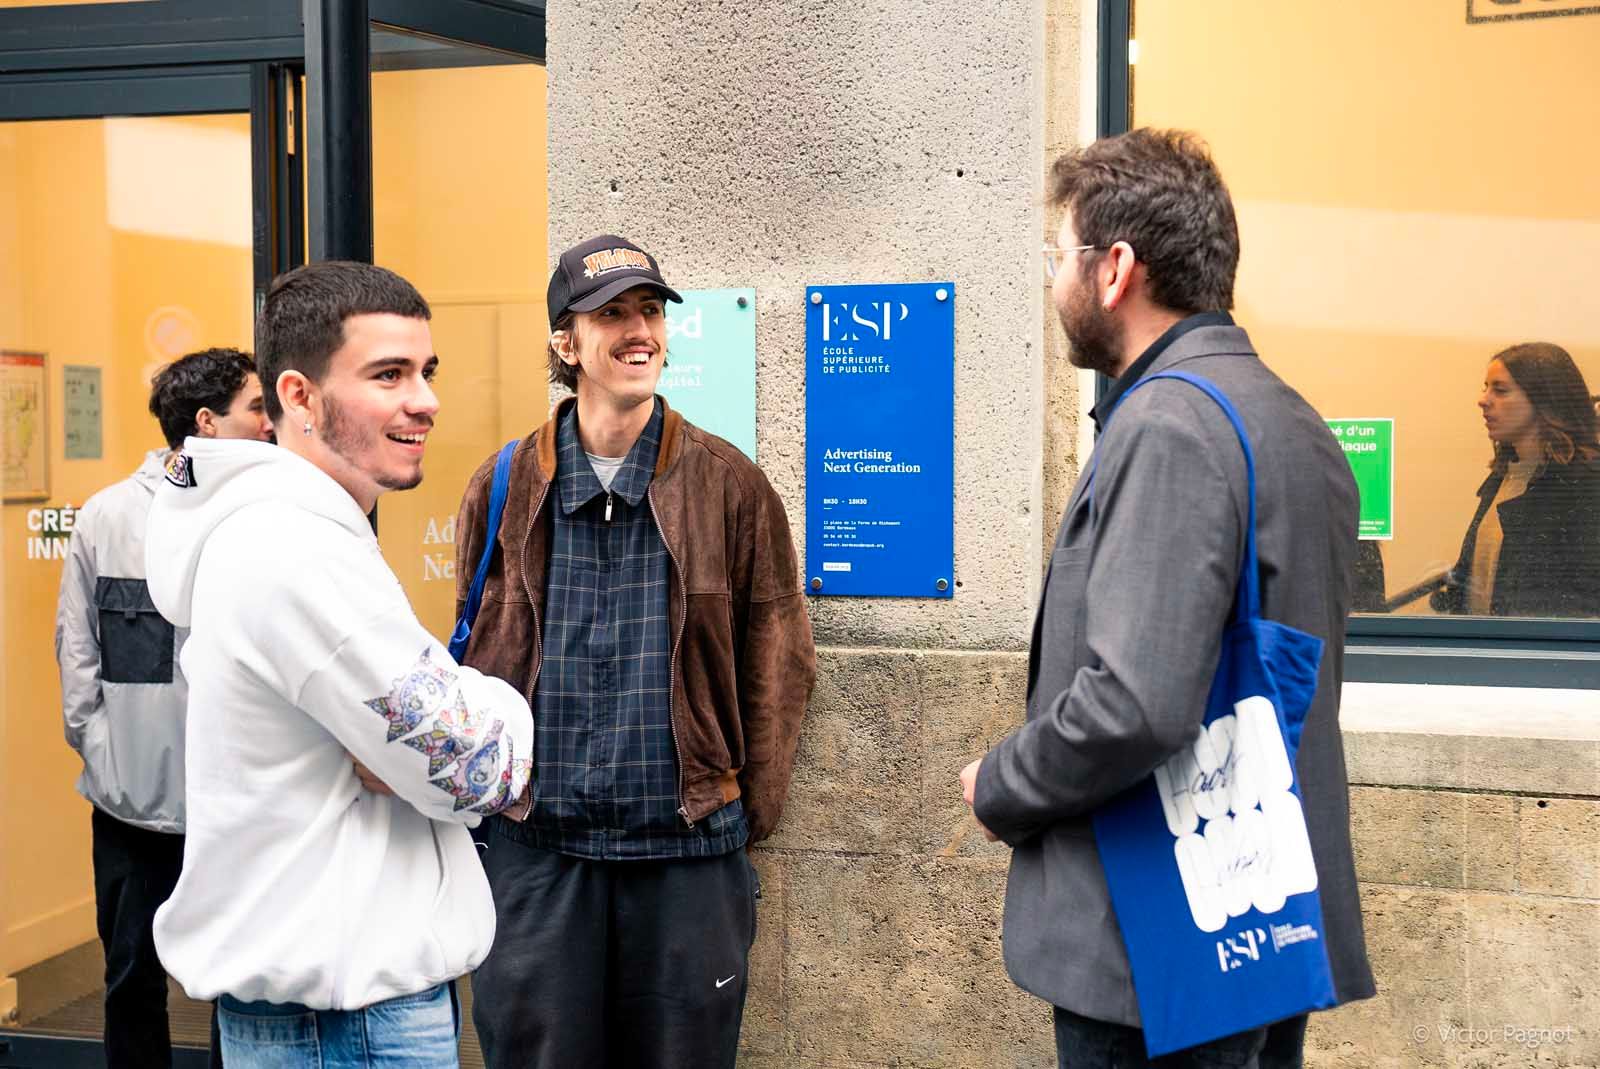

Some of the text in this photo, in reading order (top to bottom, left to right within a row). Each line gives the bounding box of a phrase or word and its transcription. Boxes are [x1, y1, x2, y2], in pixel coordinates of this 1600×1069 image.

[823, 302, 909, 341] ESP
[823, 346, 855, 355] ÉCOLE
[823, 355, 884, 364] SUPÉRIEURE
[823, 364, 891, 374] DE PUBLICITÉ
[1346, 425, 1376, 436] d'un
[1339, 441, 1377, 454] iaque
[823, 448, 893, 463] Advertising
[823, 461, 921, 473] Next Generation
[27, 504, 82, 532] CRÉ
[1216, 927, 1267, 973] ESP
